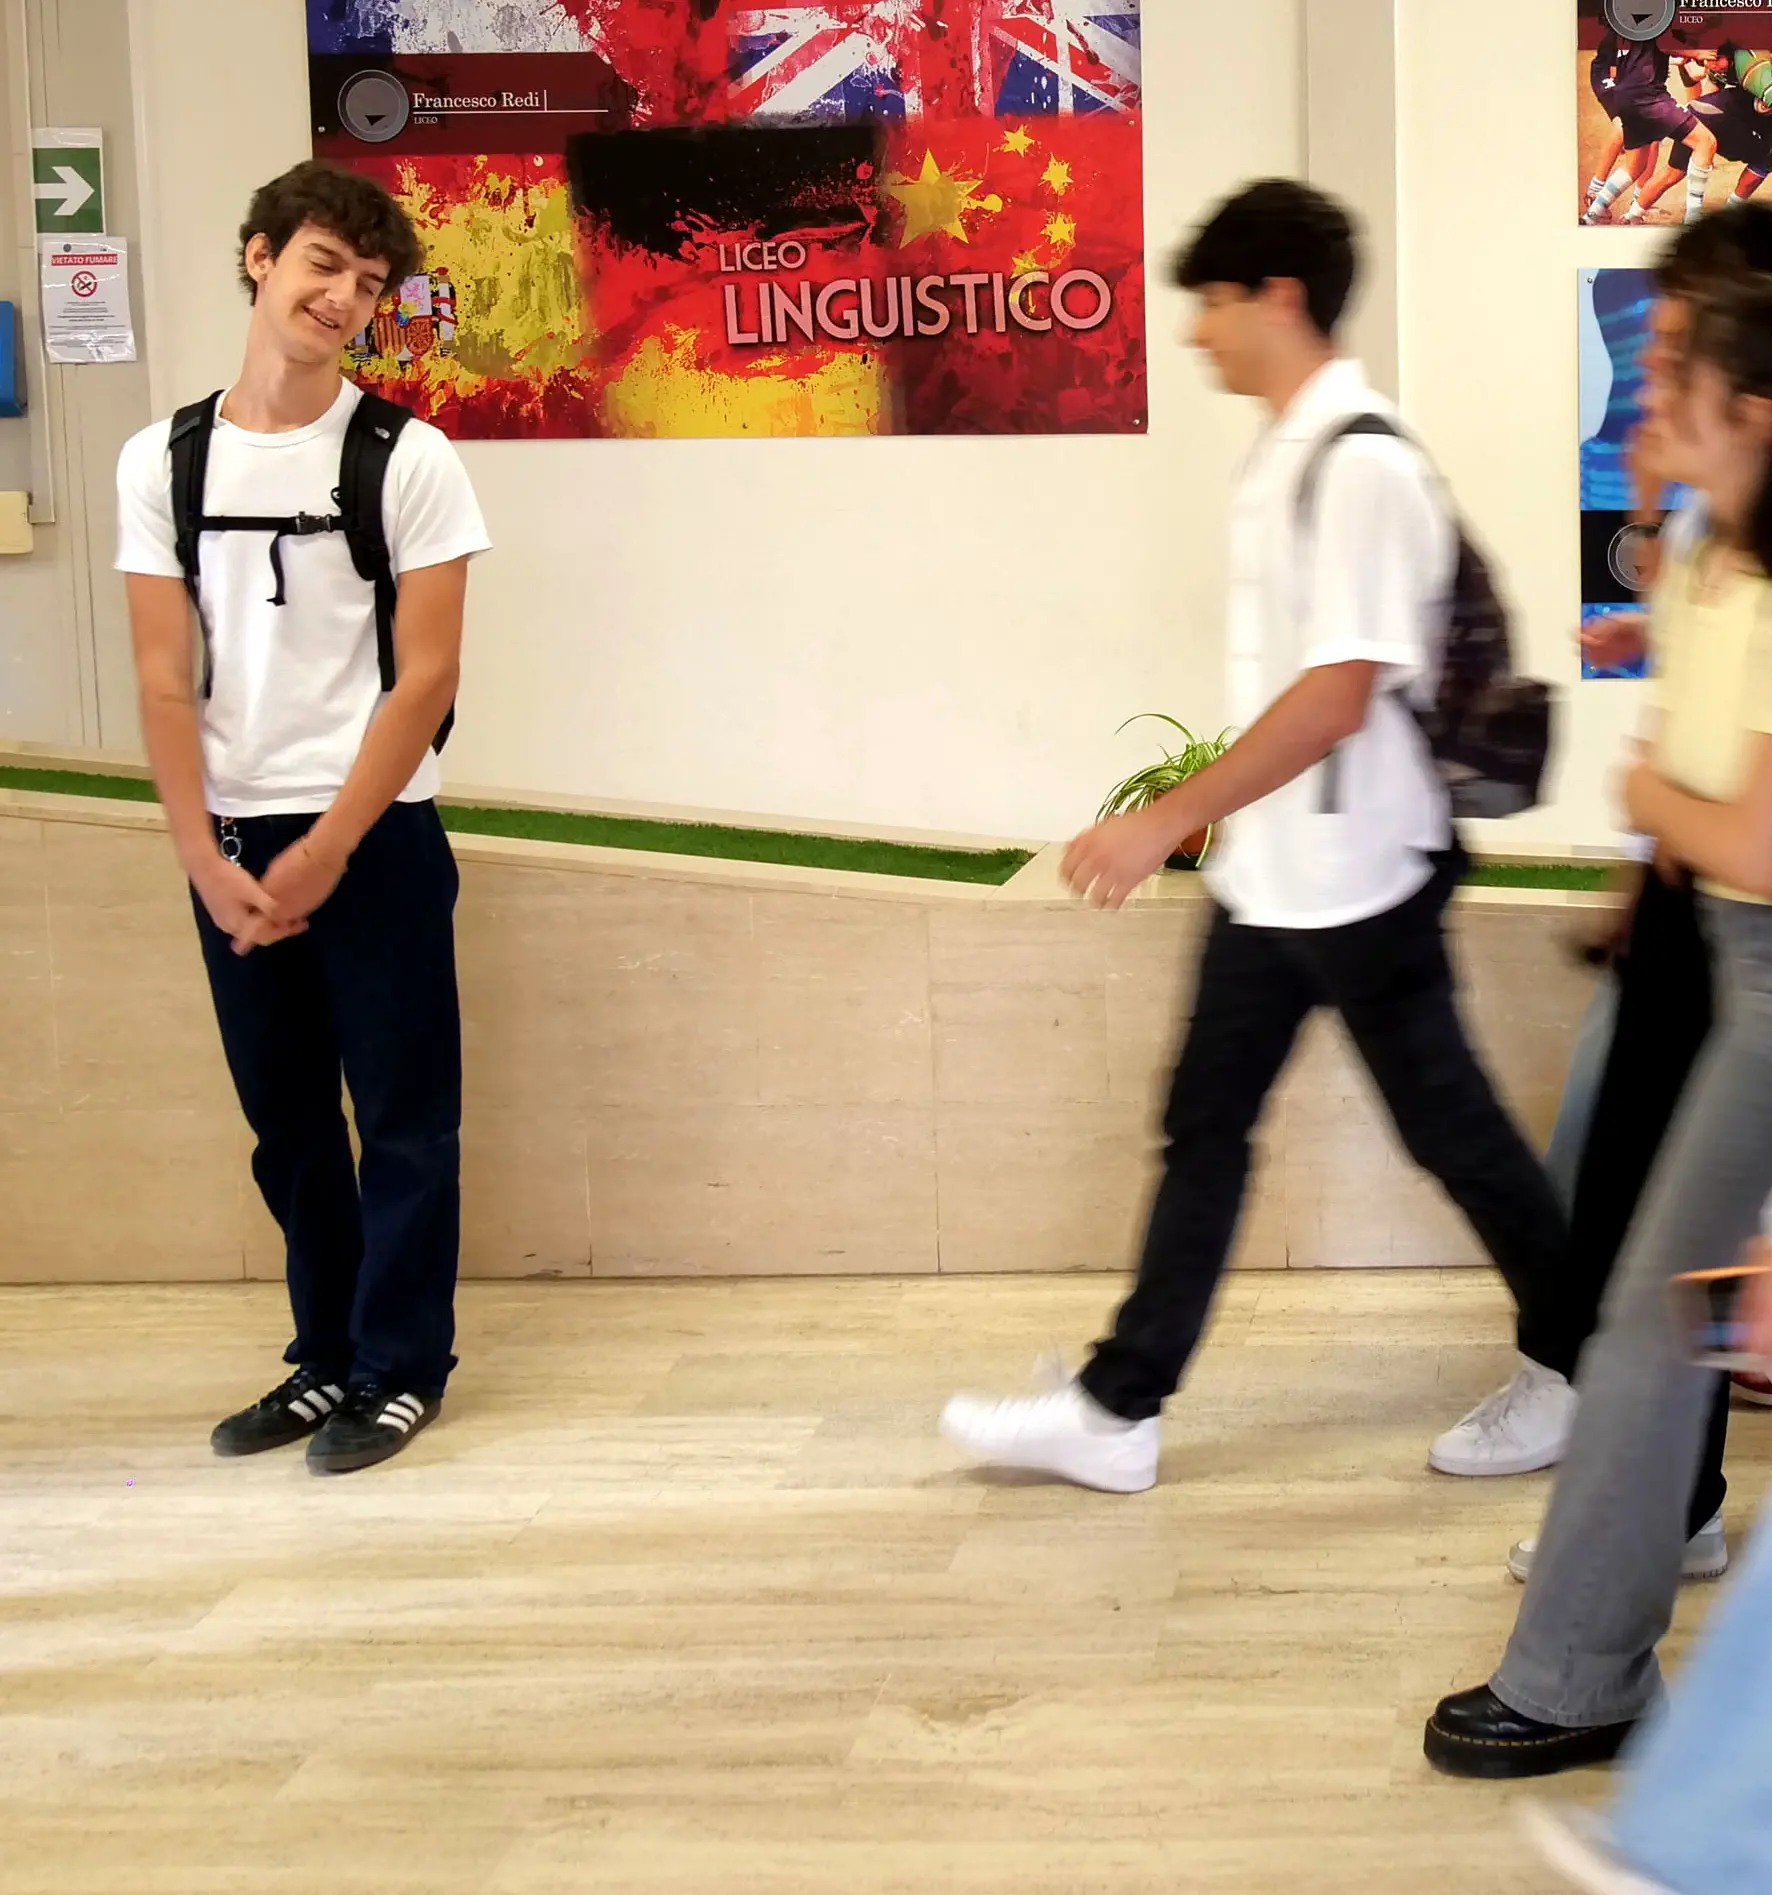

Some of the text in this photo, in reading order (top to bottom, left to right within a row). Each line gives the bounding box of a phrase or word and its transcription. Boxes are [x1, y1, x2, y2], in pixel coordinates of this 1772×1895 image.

[1679, 15, 1703, 24] LICEO
[412, 91, 540, 108] Francesco Redi
[414, 116, 438, 124] LICEO
[719, 241, 806, 272] LICEO
[724, 269, 1112, 345] LINGUISTICO
